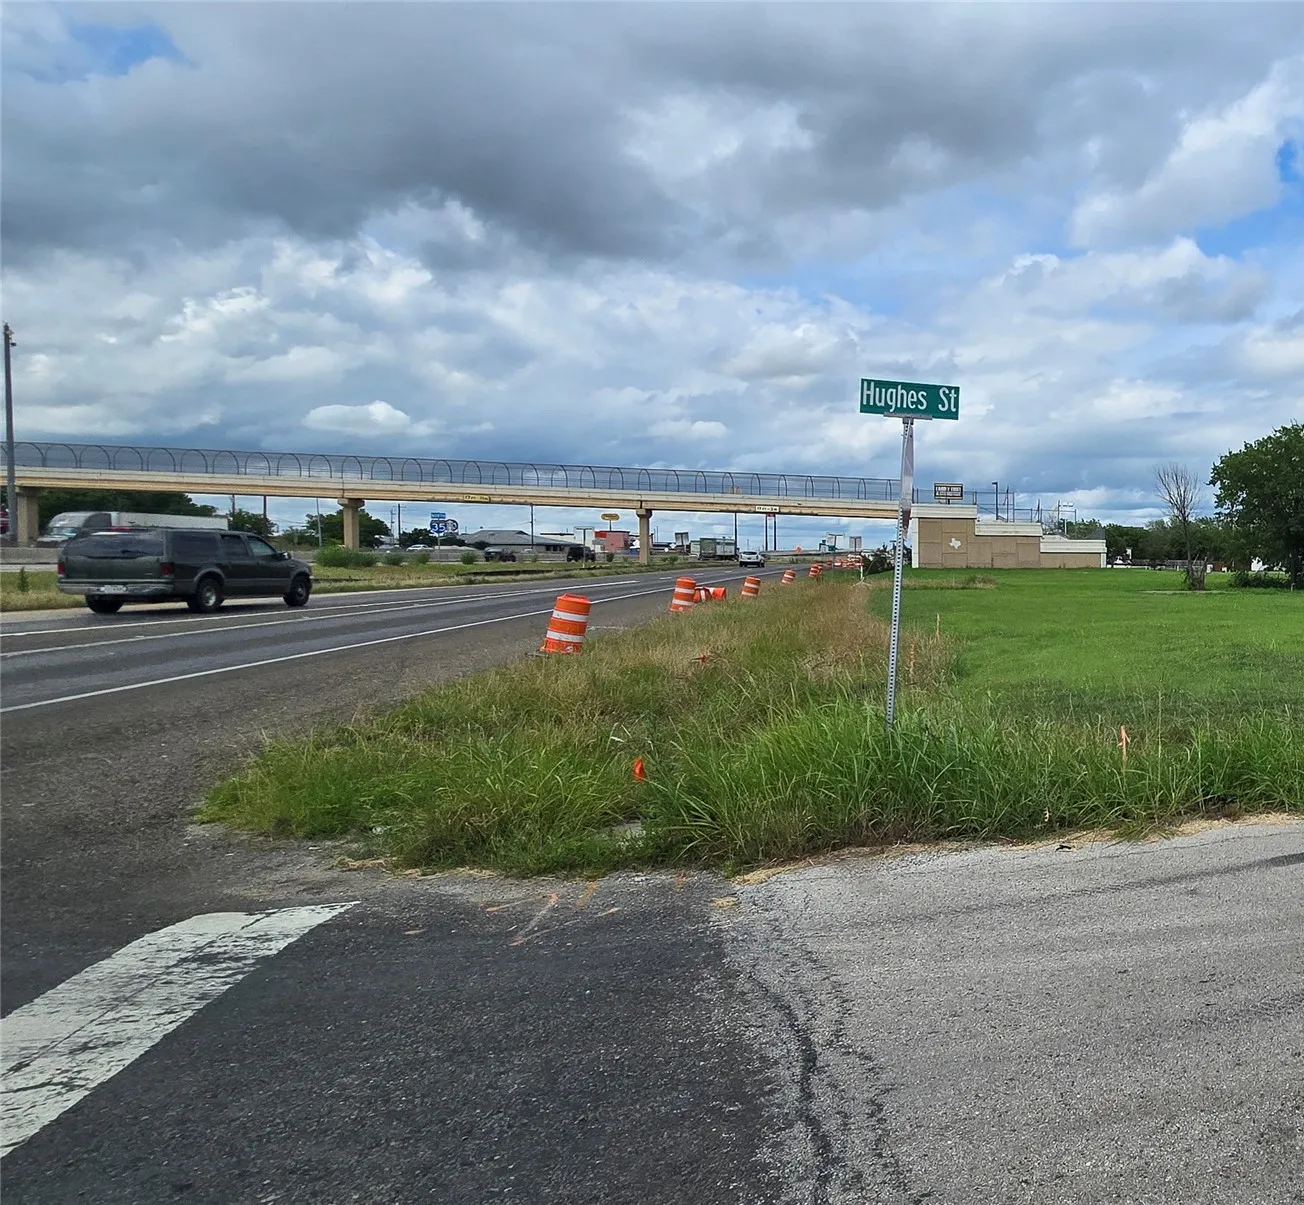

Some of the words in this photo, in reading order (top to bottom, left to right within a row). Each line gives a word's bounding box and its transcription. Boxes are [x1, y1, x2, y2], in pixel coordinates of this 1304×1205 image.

[862, 381, 927, 412] Hughes
[938, 386, 957, 412] St
[432, 523, 446, 531] 35
